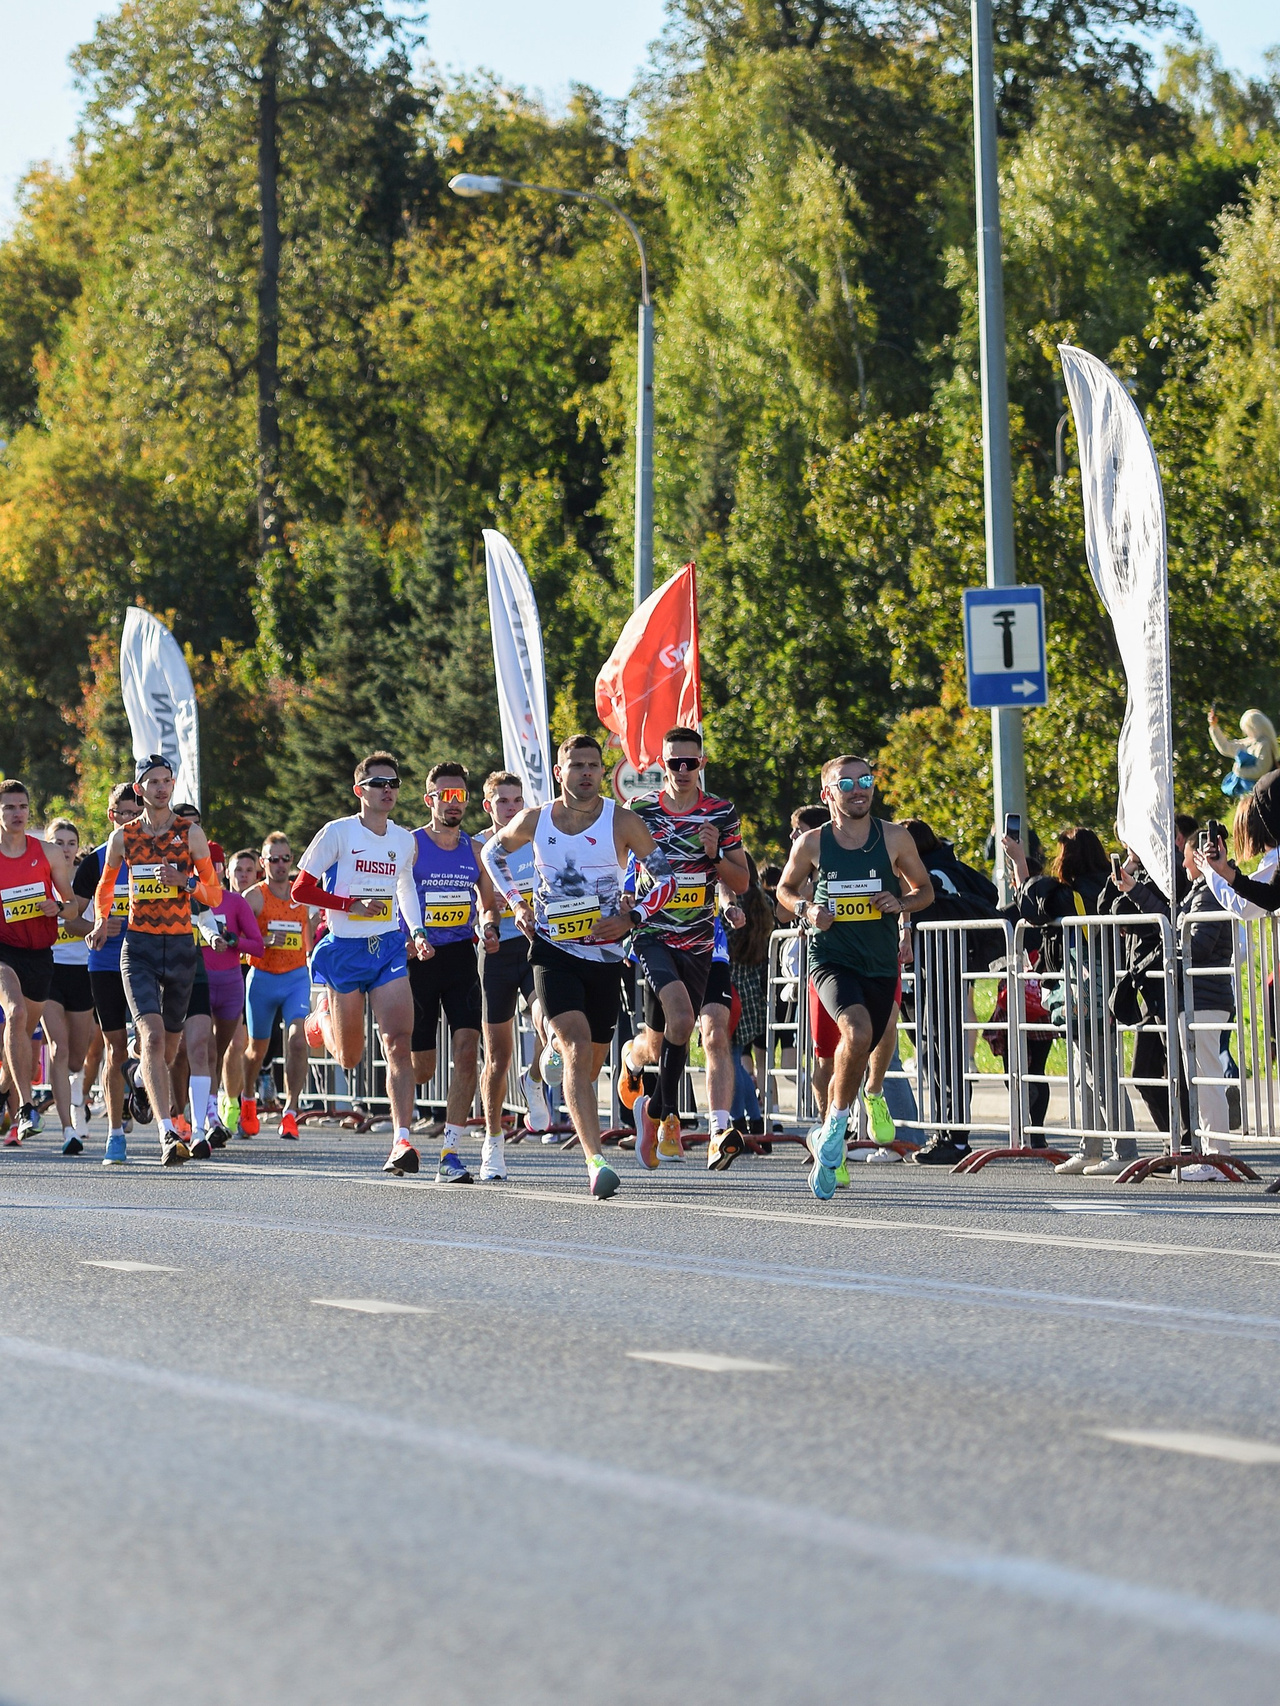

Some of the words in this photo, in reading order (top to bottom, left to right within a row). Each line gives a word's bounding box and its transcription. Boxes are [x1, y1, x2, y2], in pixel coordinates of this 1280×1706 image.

[355, 859, 396, 876] RUSSIA
[139, 884, 170, 894] 4465
[421, 879, 475, 889] PROGRESSIVE
[669, 892, 698, 903] 540
[837, 903, 872, 915] 3001
[433, 911, 464, 921] 4679
[558, 918, 593, 934] 5577
[286, 937, 297, 946] 28
